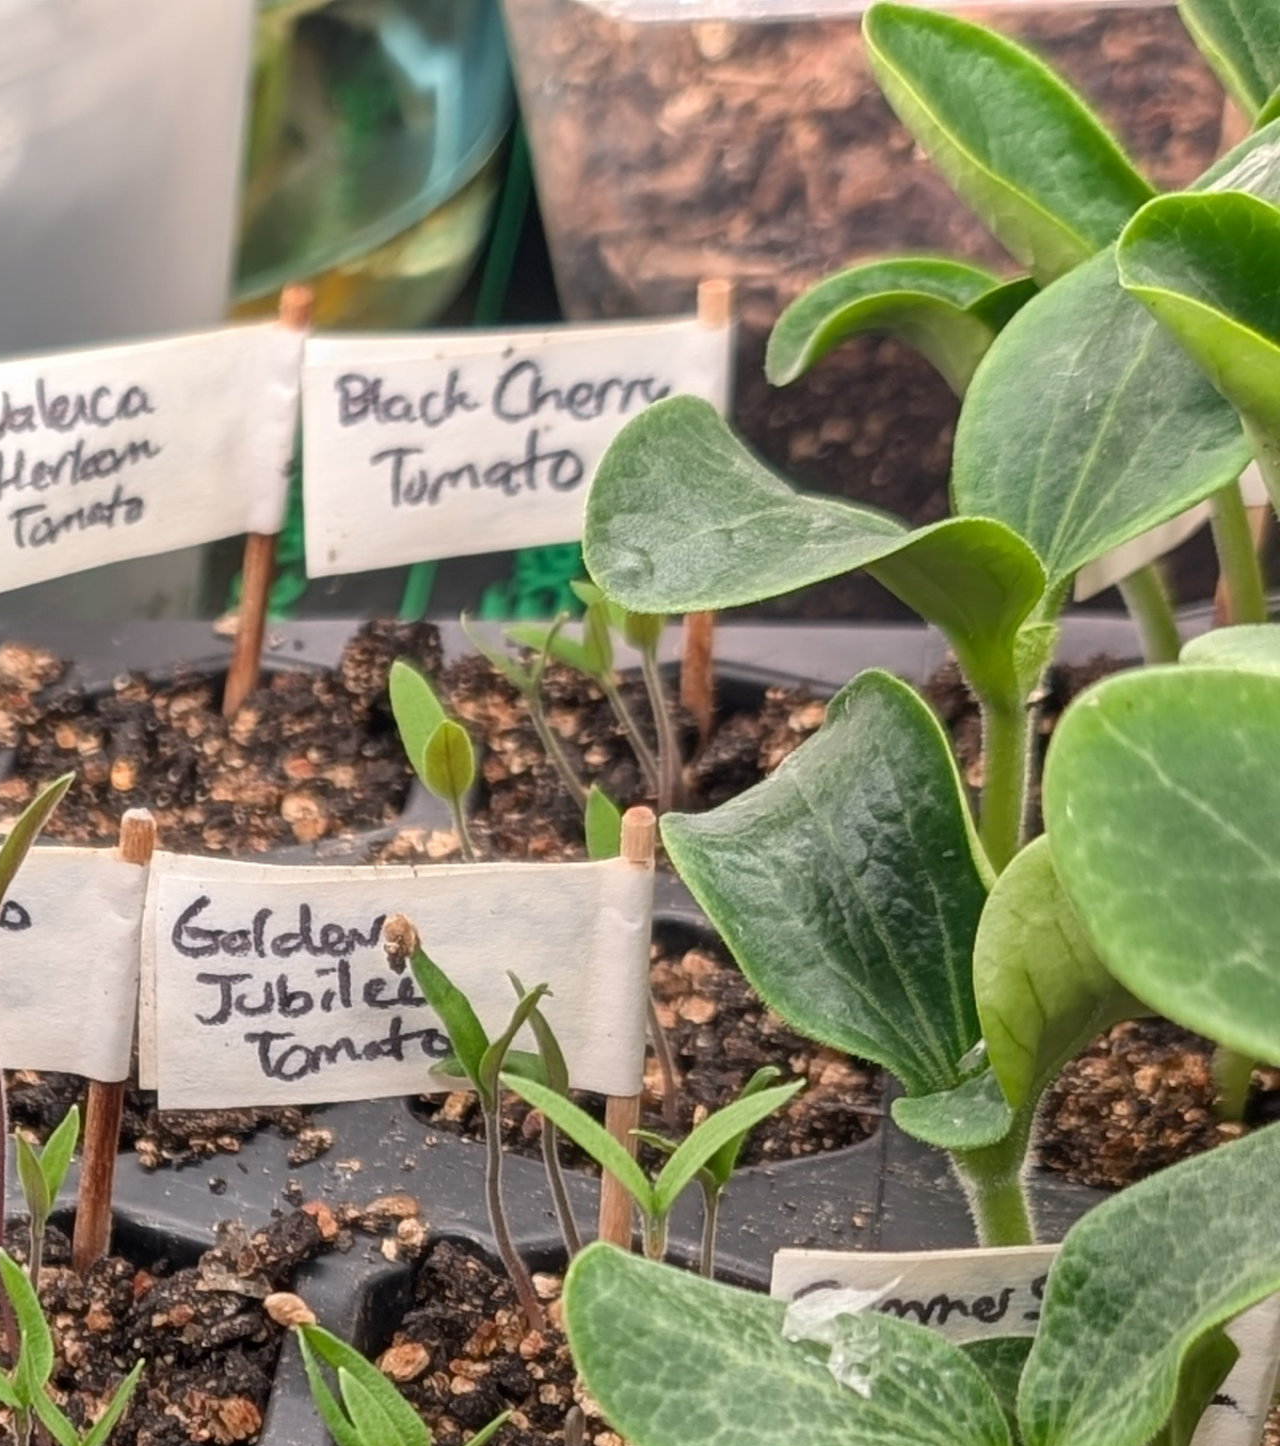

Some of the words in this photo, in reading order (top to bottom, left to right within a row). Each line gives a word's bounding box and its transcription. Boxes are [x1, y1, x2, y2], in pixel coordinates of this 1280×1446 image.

[335, 368, 479, 427] Black
[370, 428, 585, 508] Tomato
[9, 486, 146, 549] Tomato
[171, 894, 387, 959] Golden
[194, 959, 428, 1027] Jubilee
[244, 1016, 455, 1083] Tomato
